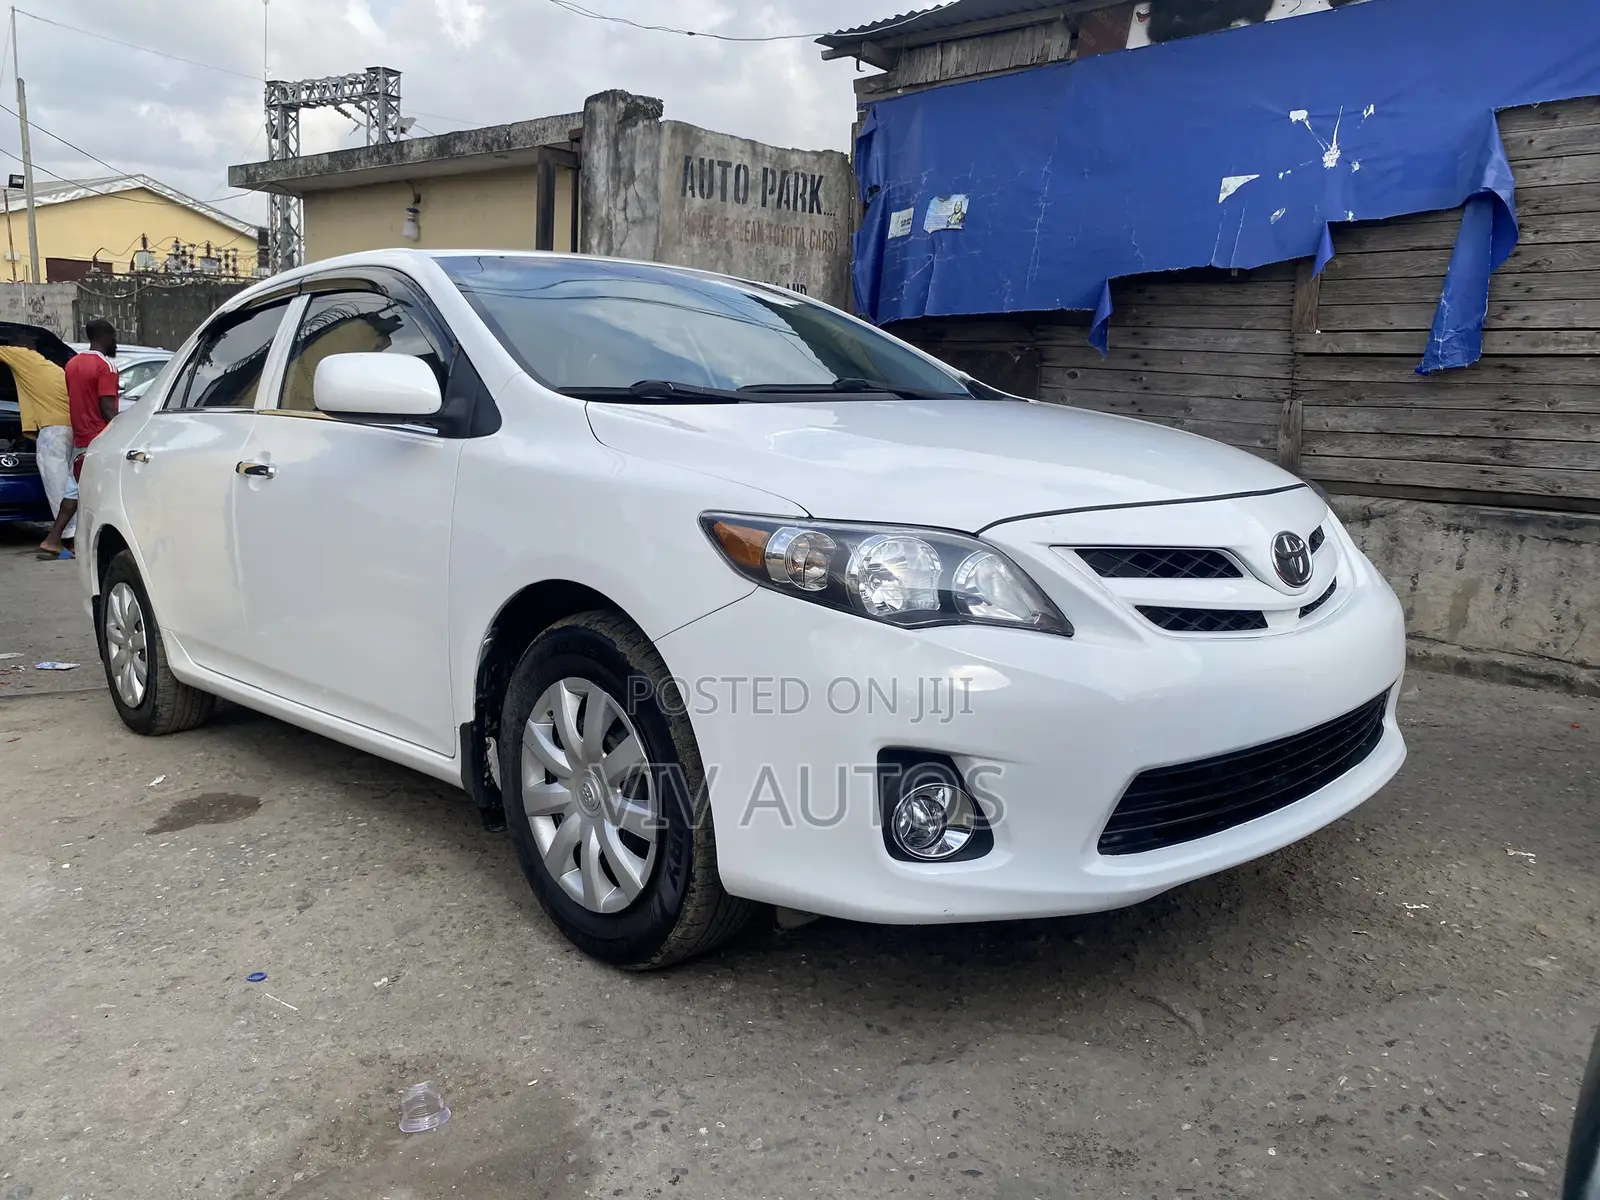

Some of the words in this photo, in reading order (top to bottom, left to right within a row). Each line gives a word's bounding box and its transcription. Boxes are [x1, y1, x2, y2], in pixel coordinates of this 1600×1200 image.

[681, 155, 749, 205] AUTO
[733, 219, 764, 245] CLEAN
[767, 223, 807, 249] TOYOTA
[809, 229, 838, 252] CARS)
